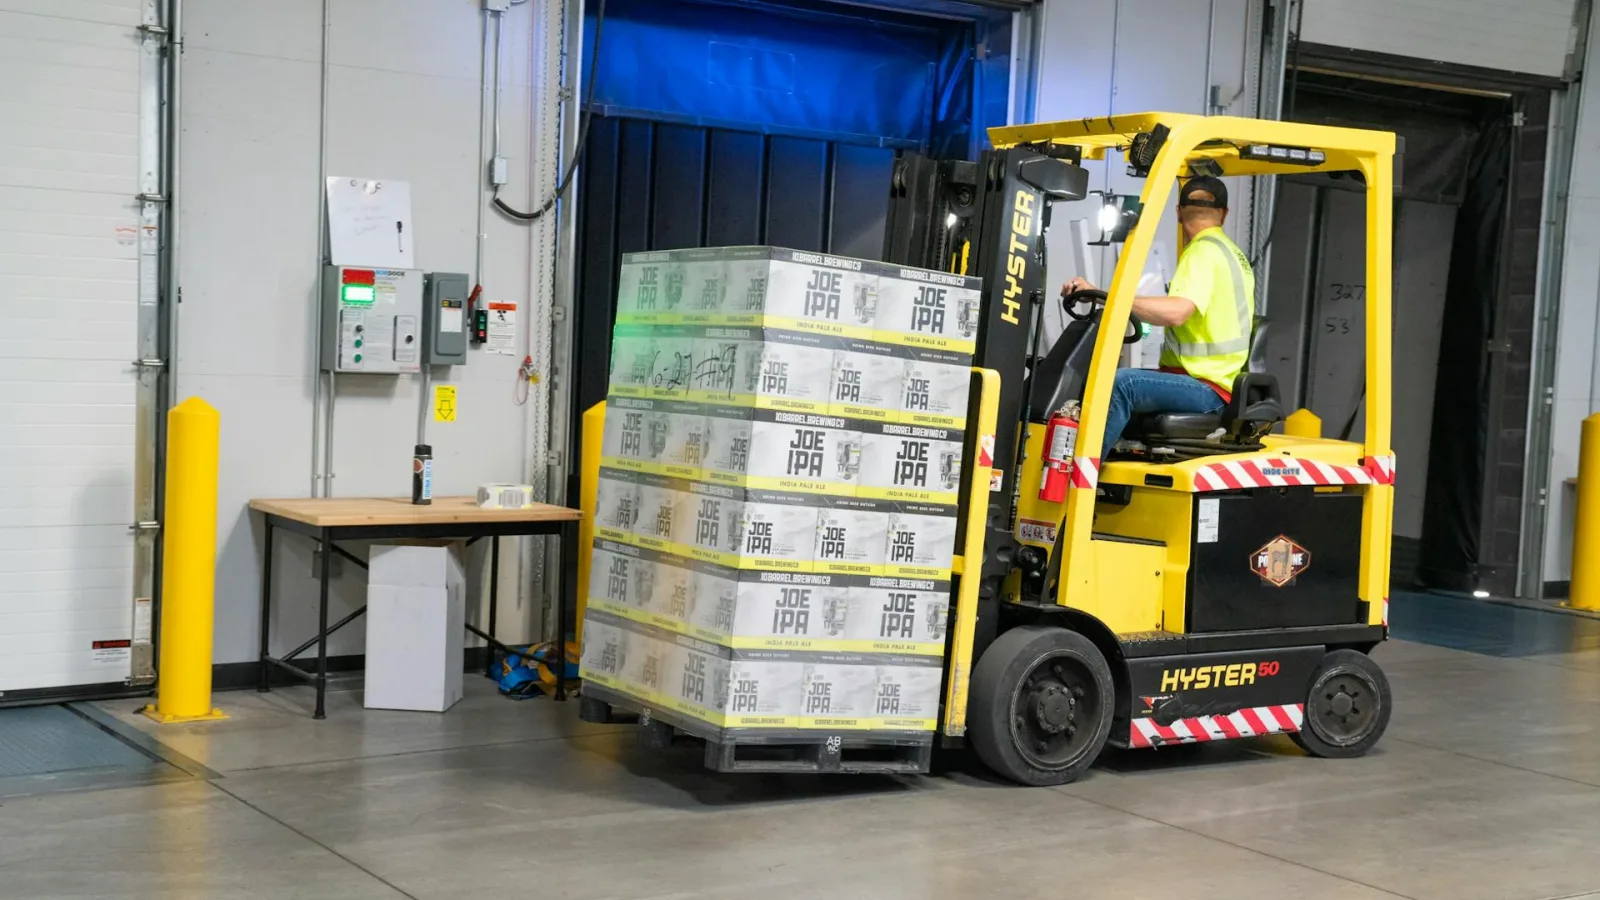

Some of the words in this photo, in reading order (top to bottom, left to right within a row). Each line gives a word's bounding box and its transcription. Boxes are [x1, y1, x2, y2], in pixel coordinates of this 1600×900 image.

[1001, 190, 1034, 325] HYSTER
[640, 267, 658, 285] JOE
[748, 278, 764, 292] JOE
[807, 270, 842, 293] JOE
[637, 286, 657, 309] IPA
[746, 293, 762, 310] IPA
[804, 290, 841, 319] IPA
[914, 286, 947, 308] JOE
[796, 322, 815, 330] INDIA
[911, 306, 945, 333] IPA
[764, 361, 788, 376] JOE
[838, 370, 861, 384] JOE
[762, 375, 788, 395] IPA
[836, 383, 860, 402] IPA
[908, 378, 930, 393] JOE
[906, 392, 928, 411] IPA
[623, 412, 642, 431] JOE
[620, 432, 640, 456] IPA
[731, 438, 747, 452] JOE
[790, 429, 825, 450] JOE
[684, 445, 700, 464] IPA
[897, 441, 929, 461] JOE
[729, 453, 746, 471] IPA
[787, 450, 824, 477] IPA
[894, 460, 927, 487] IPA
[658, 506, 672, 520] JOE
[698, 499, 720, 521] JOE
[616, 512, 630, 529] IPA
[656, 520, 671, 537] IPA
[749, 522, 773, 536] JOE
[696, 520, 719, 547] IPA
[823, 527, 846, 541] JOE
[893, 532, 915, 545] JOE
[746, 536, 772, 555] IPA
[821, 541, 844, 559] IPA
[891, 545, 914, 562] IPA
[610, 556, 629, 577] JOE
[608, 576, 627, 602] IPA
[776, 588, 811, 609] JOE
[883, 593, 916, 613] JOE
[714, 611, 730, 631] IPA
[772, 609, 809, 634] IPA
[880, 613, 915, 638] IPA
[602, 656, 616, 674] IPA
[685, 652, 706, 677] JOE
[1161, 663, 1256, 692] HYSTER
[1258, 661, 1279, 676] 50
[682, 673, 704, 702] IPA
[734, 680, 759, 694] JOE
[809, 682, 832, 696] JOE
[878, 684, 900, 697] JOE
[732, 694, 757, 712] IPA
[806, 696, 830, 713] IPA
[876, 698, 900, 714] IPA
